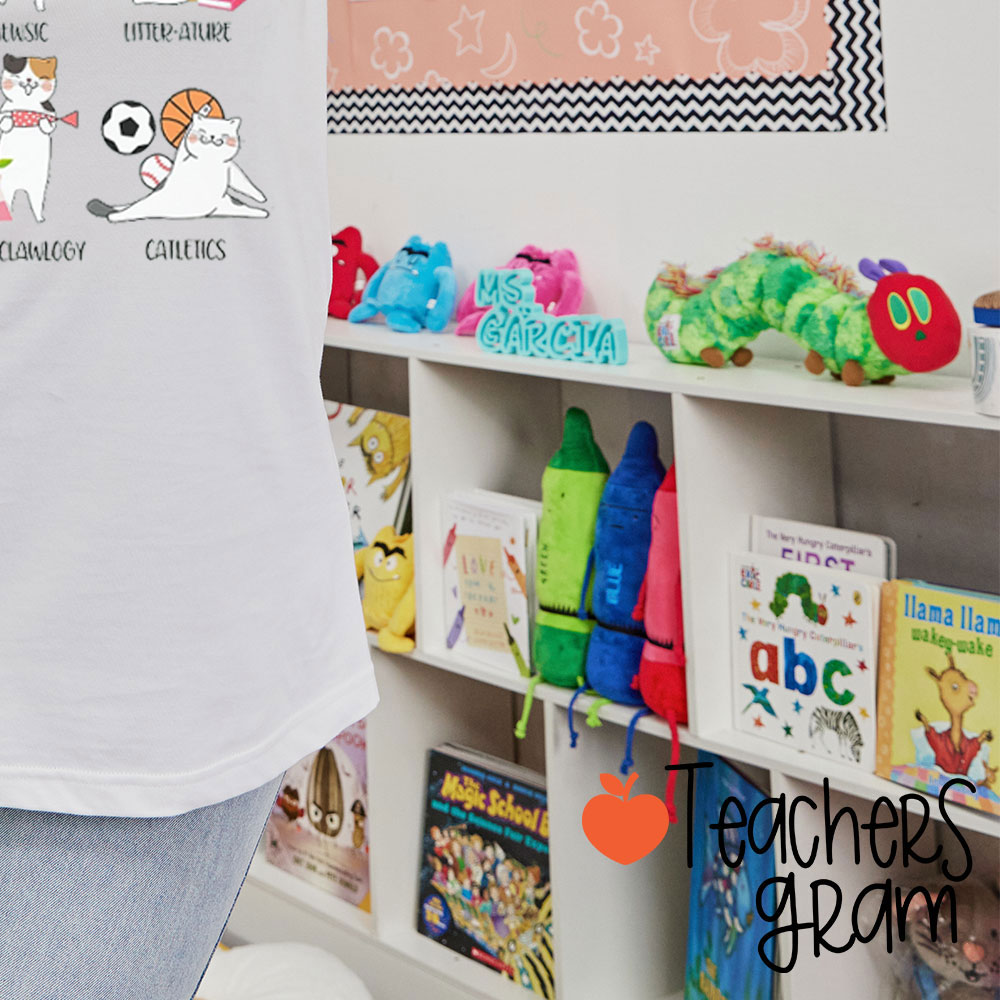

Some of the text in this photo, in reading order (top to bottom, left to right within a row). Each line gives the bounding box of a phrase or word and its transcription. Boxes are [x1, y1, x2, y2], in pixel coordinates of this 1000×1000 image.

[145, 238, 227, 261] CATLETICS
[479, 313, 617, 362] GARCIA
[904, 593, 955, 627] llama
[911, 627, 994, 658] wakey-wake
[750, 636, 856, 707] abc
[440, 771, 487, 811] Magic
[486, 788, 541, 833] School
